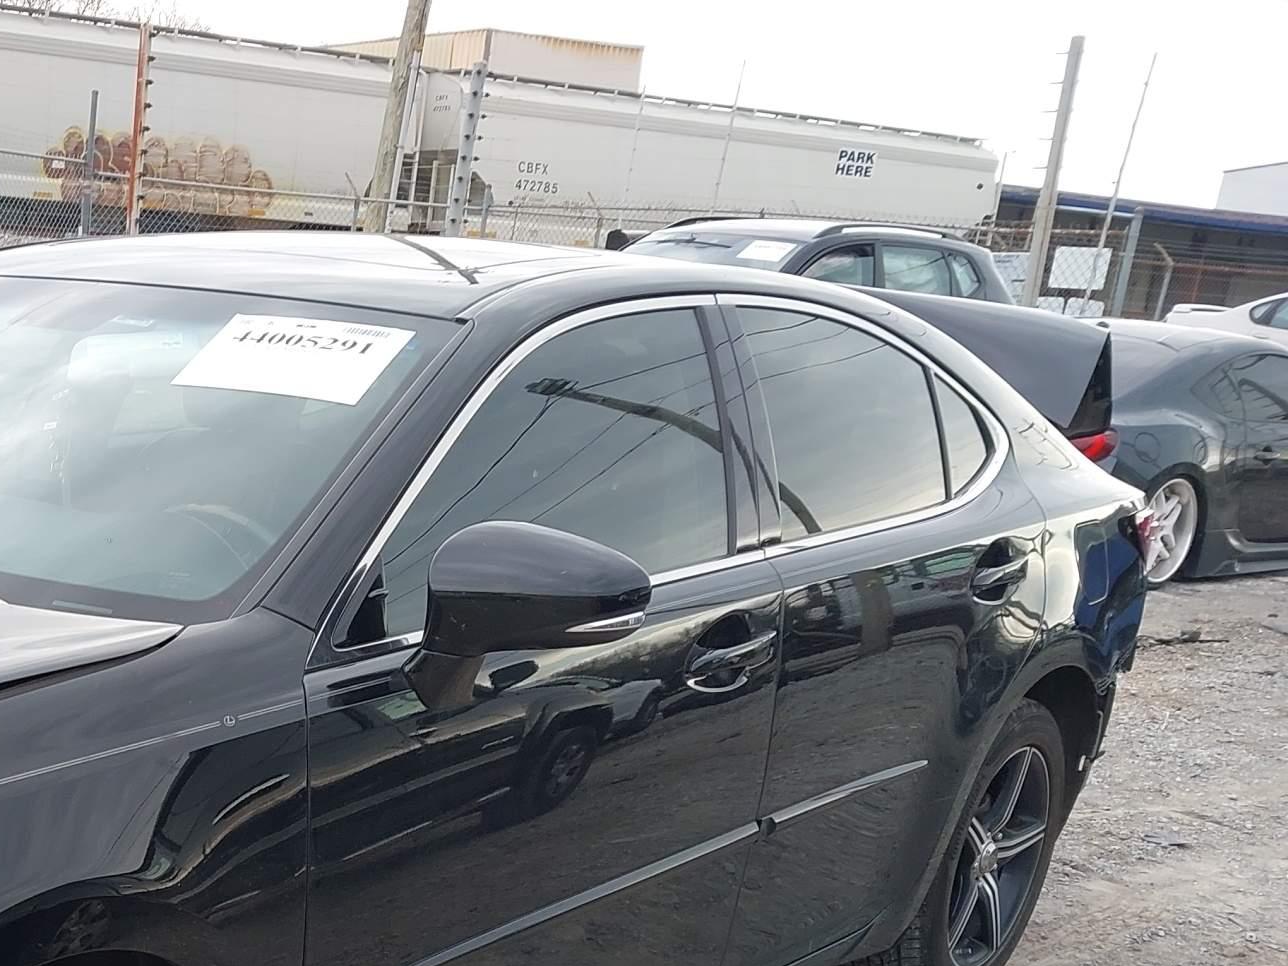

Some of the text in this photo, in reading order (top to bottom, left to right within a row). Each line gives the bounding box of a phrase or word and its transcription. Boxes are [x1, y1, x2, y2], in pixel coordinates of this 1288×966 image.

[839, 150, 876, 164] PARK
[518, 161, 549, 175] CBFX
[835, 163, 872, 177] HERE
[515, 179, 558, 194] 472785
[233, 330, 373, 354] 44005291
